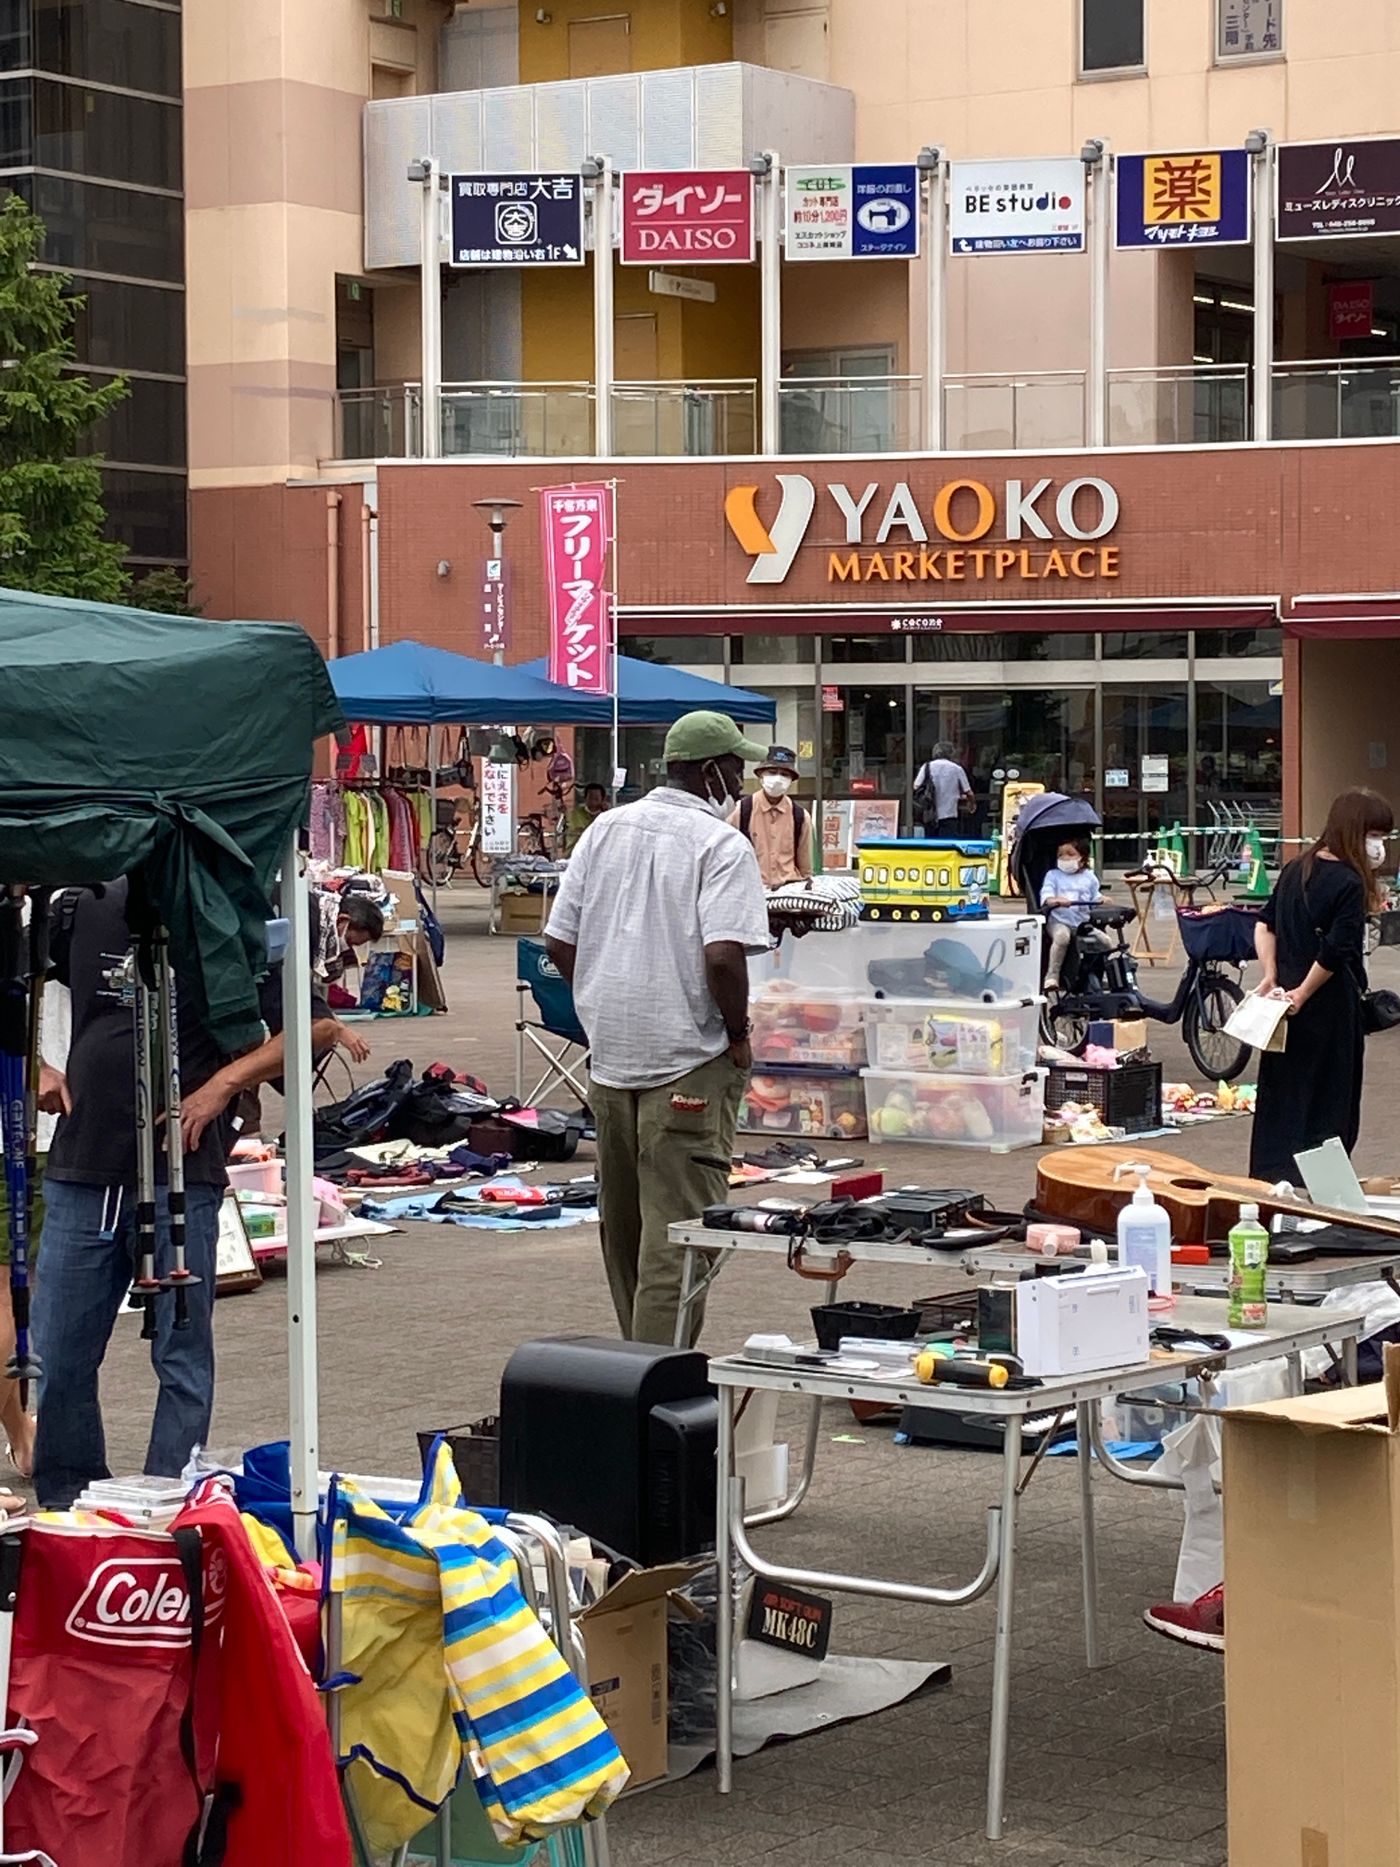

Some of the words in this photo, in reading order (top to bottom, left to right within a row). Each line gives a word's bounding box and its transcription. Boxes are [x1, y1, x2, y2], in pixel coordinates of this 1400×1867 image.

[1263, 0, 1277, 49] ード先
[632, 184, 742, 216] ダイソー
[965, 194, 990, 214] BE
[1152, 158, 1212, 221] 薬
[639, 228, 736, 250] DAISO
[827, 478, 1120, 544] YAOKO
[827, 546, 1121, 583] MARKETPLACE
[96, 1572, 191, 1624] Cole
[761, 1606, 819, 1649] MK48C
